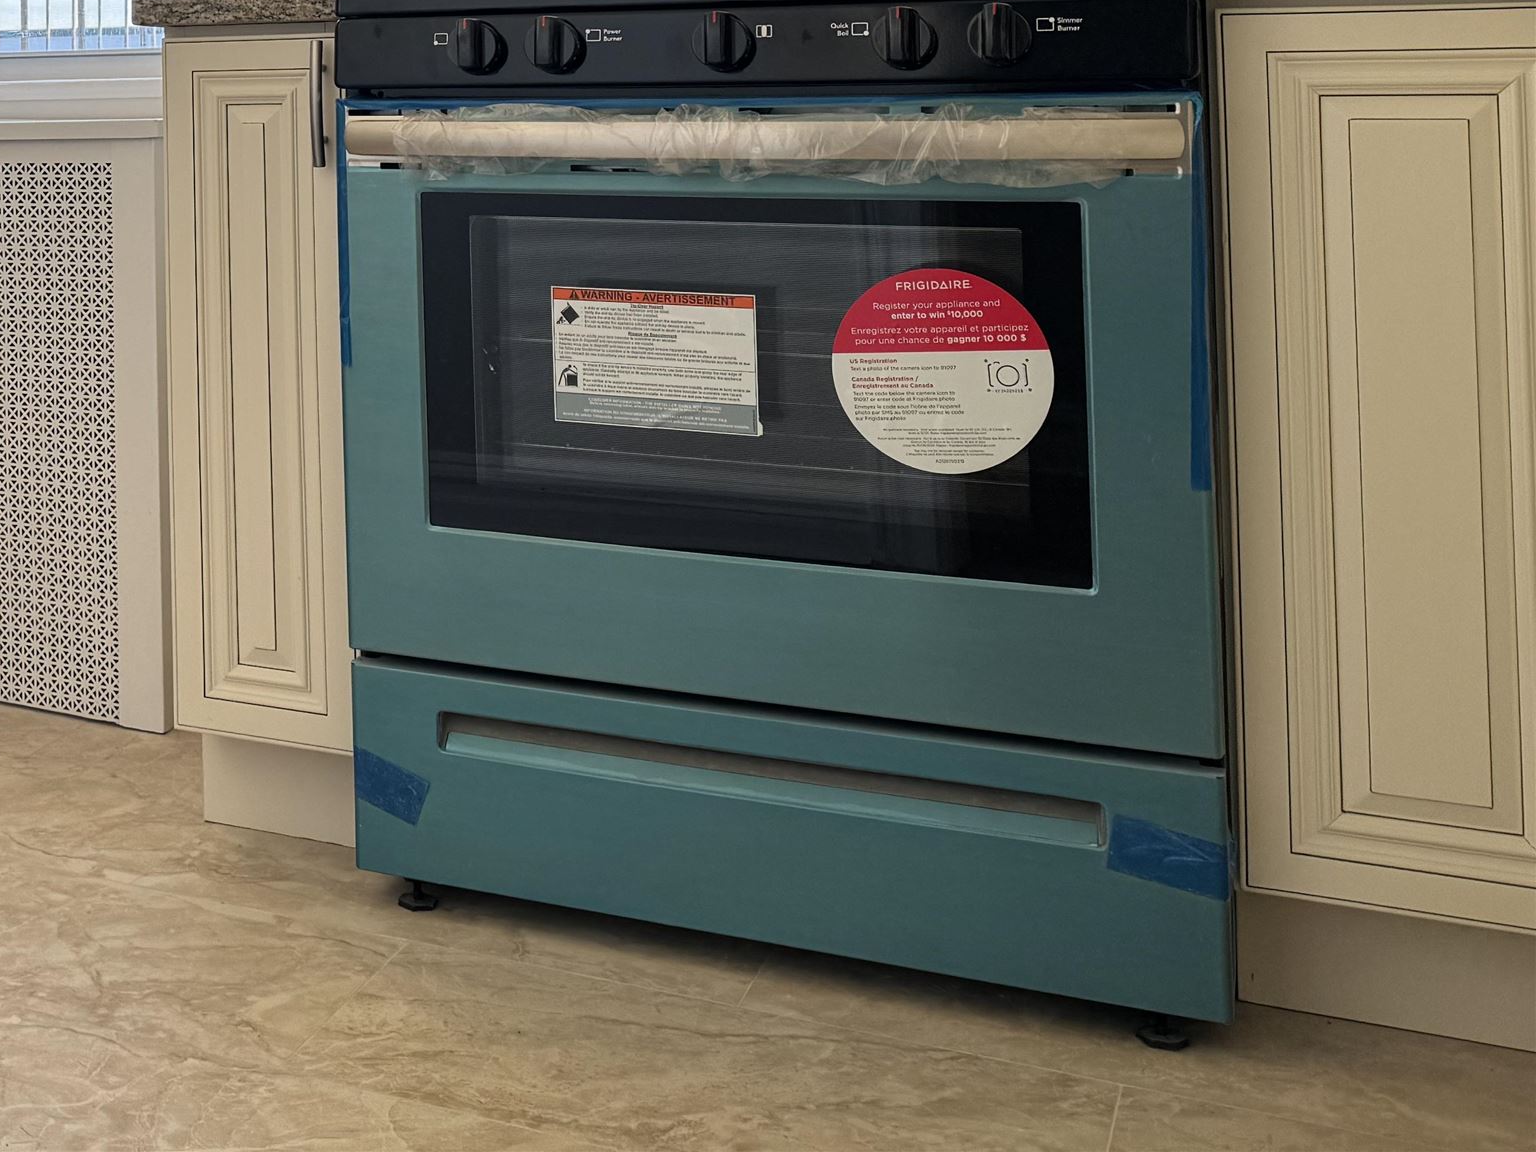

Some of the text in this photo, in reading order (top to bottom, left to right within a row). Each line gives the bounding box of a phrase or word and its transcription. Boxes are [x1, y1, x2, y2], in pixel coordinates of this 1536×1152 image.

[895, 279, 971, 291] FRIGIDAIRE
[581, 290, 632, 301] WARNING
[642, 293, 736, 306] AVERTISSEMENT
[873, 299, 1000, 311] Register your appliance and
[917, 311, 926, 319] to
[929, 310, 945, 318] win
[947, 310, 983, 319] $10,000
[851, 327, 901, 335] Enregistrez
[903, 326, 928, 334] votre
[930, 325, 967, 334] appareil
[982, 324, 1029, 334] participez
[855, 337, 875, 346] pour
[898, 336, 930, 344] chance
[947, 336, 980, 345] gagner
[983, 334, 994, 342] 10
[997, 334, 1017, 342] 000
[1021, 334, 1026, 342] $
